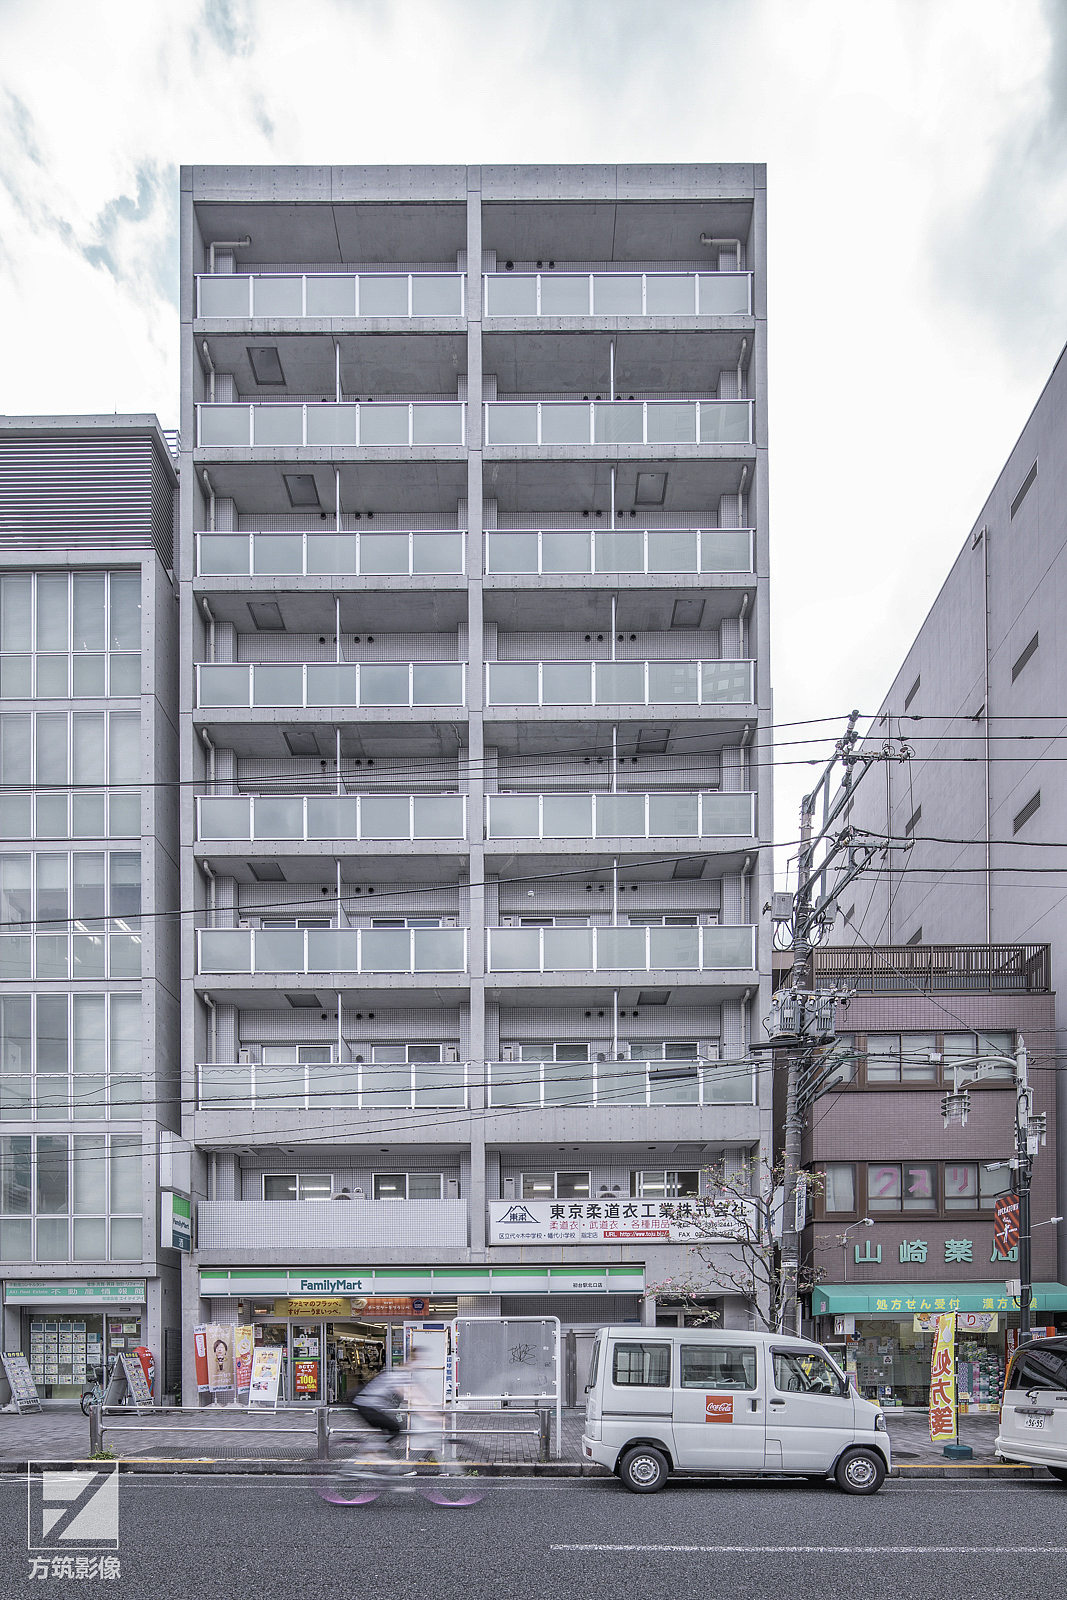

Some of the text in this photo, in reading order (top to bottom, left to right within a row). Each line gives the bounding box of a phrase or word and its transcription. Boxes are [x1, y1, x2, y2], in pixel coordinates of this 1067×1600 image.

[876, 1167, 969, 1195] クスリ
[549, 1202, 747, 1219] 東京柔道衣工業株式会社
[173, 1217, 190, 1230] FamilyMart
[300, 1279, 362, 1293] FamilyMart
[876, 1298, 961, 1310] 処方せん受付
[707, 1402, 732, 1411] Coca-Cola
